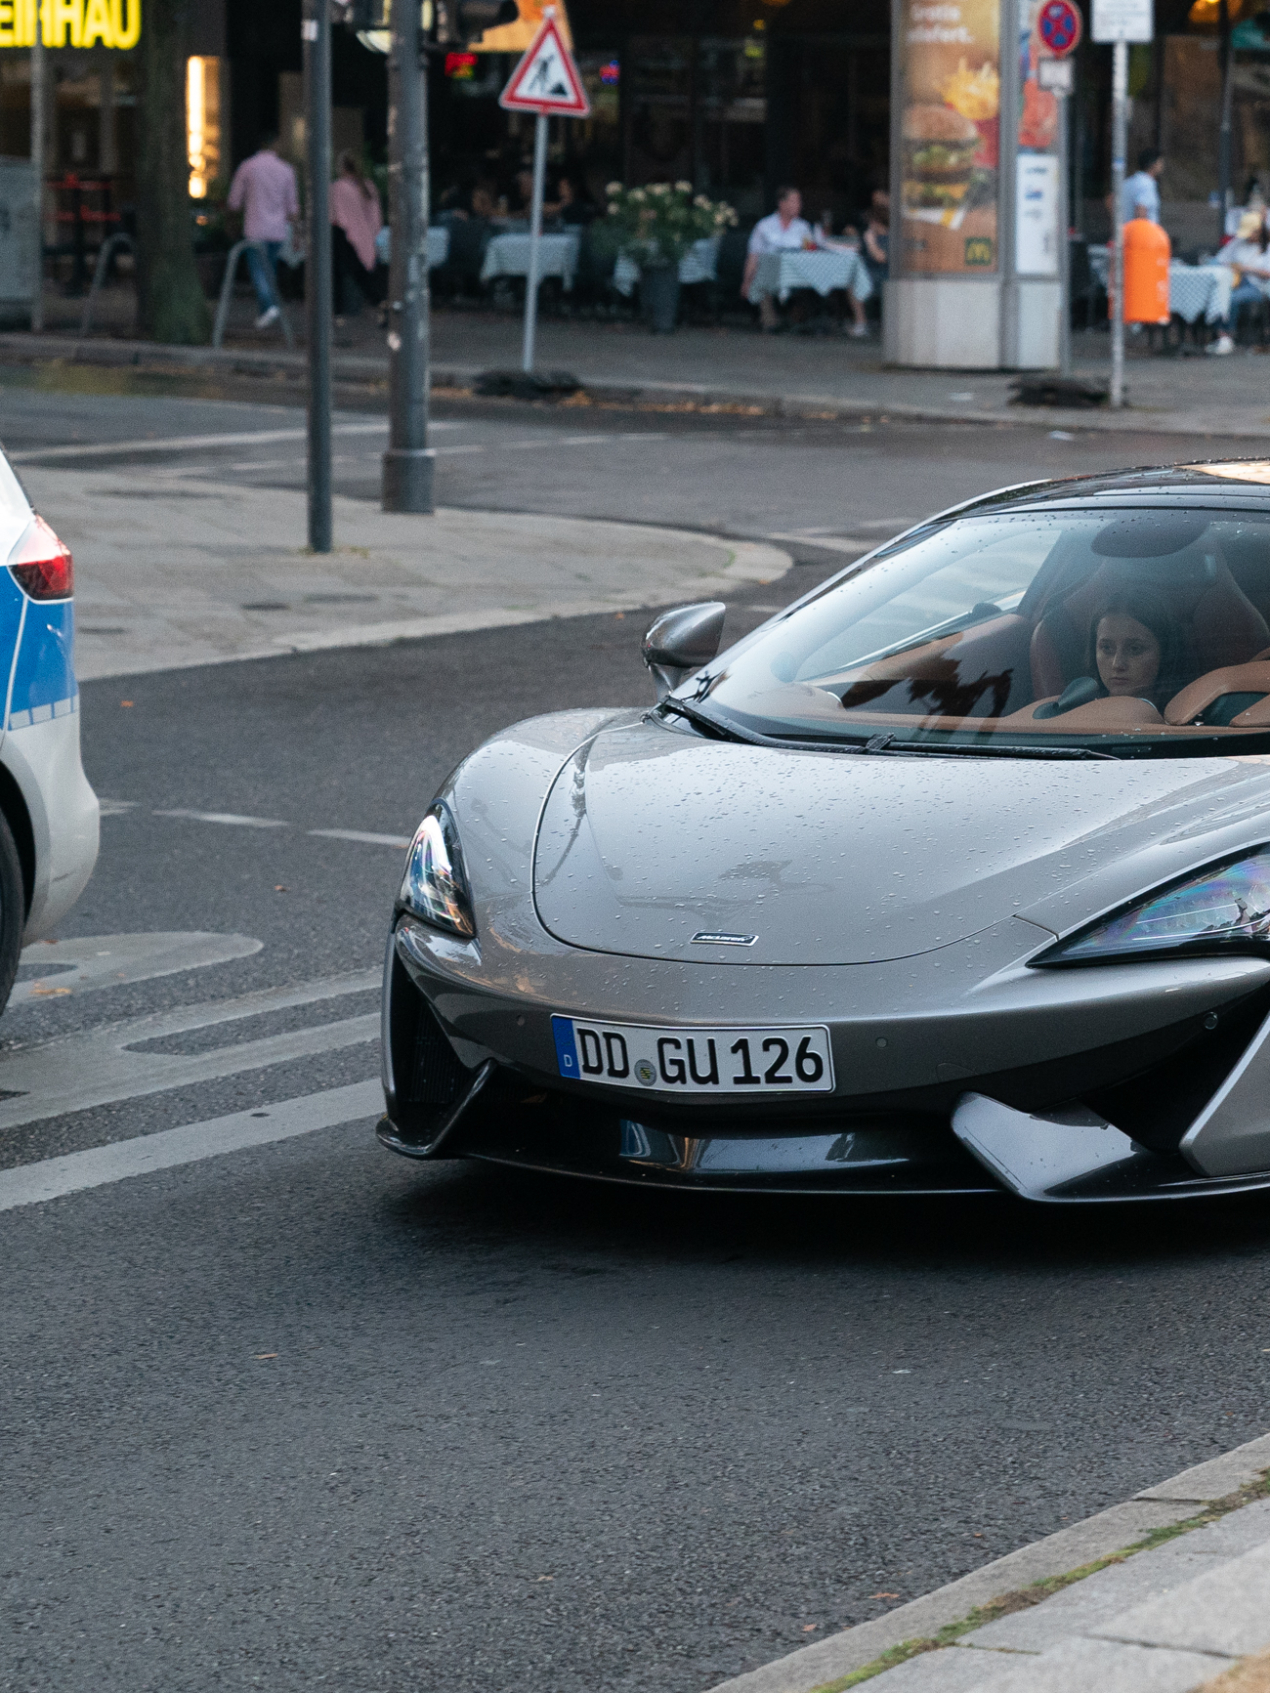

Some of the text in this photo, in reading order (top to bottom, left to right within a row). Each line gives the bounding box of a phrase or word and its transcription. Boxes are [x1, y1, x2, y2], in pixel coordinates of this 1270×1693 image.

[563, 1054, 573, 1068] D
[577, 1028, 824, 1085] DD GU 126
